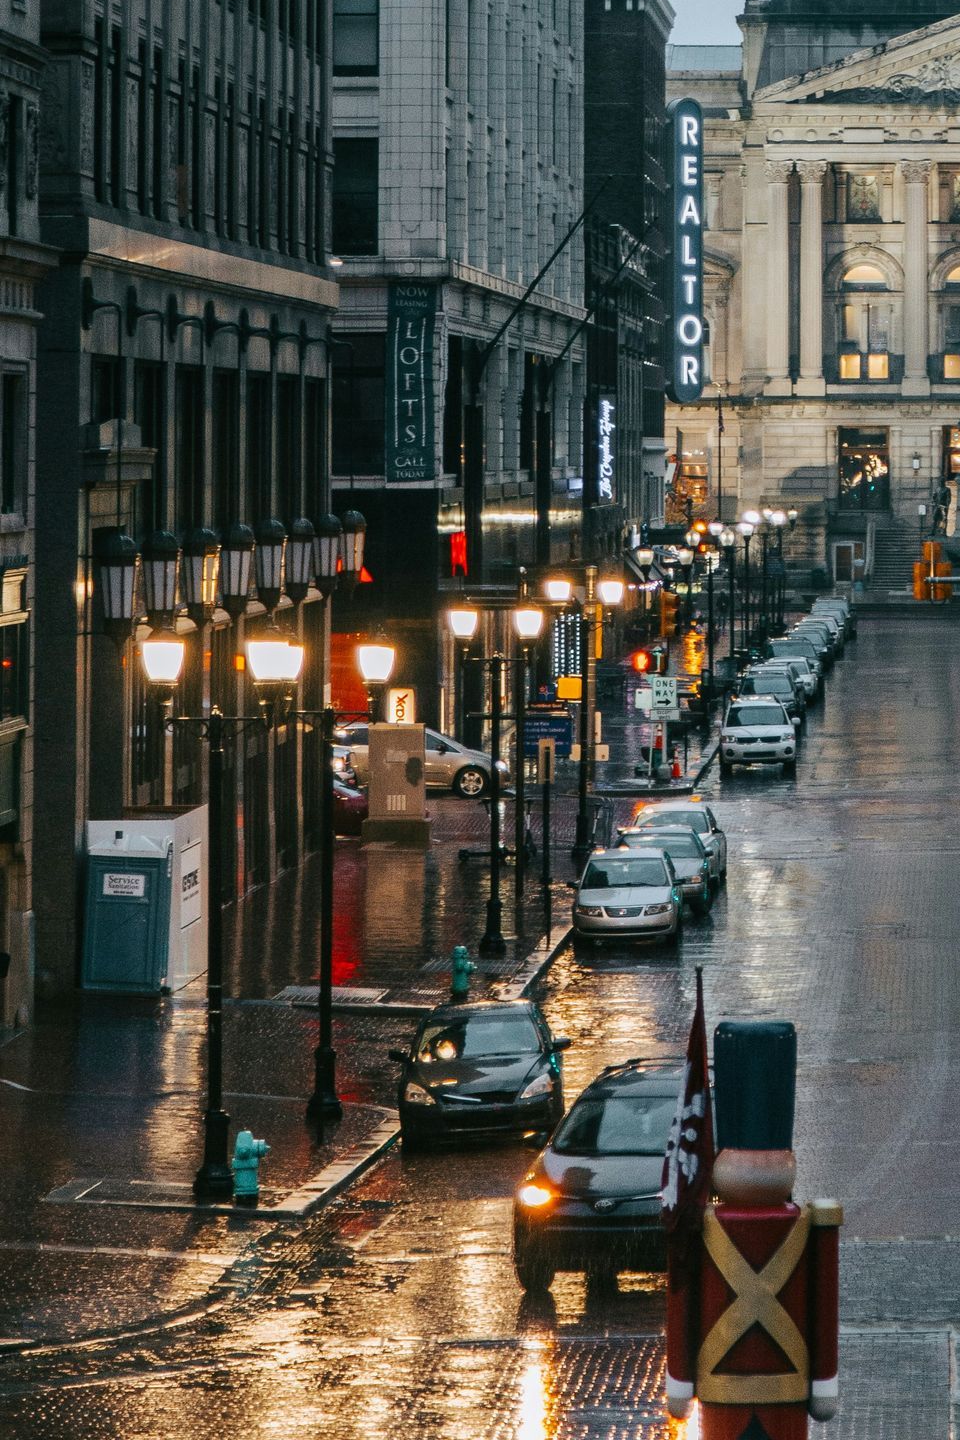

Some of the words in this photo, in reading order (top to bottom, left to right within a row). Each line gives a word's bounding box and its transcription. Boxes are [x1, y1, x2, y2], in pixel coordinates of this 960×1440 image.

[679, 116, 702, 385] REALTOR
[396, 286, 429, 297] NOW
[395, 299, 428, 308] LEASING
[400, 321, 419, 443] LOFTS
[395, 455, 427, 468] CALL
[395, 470, 426, 478] TODAY
[656, 680, 674, 688] ONE
[108, 875, 140, 885] Service
